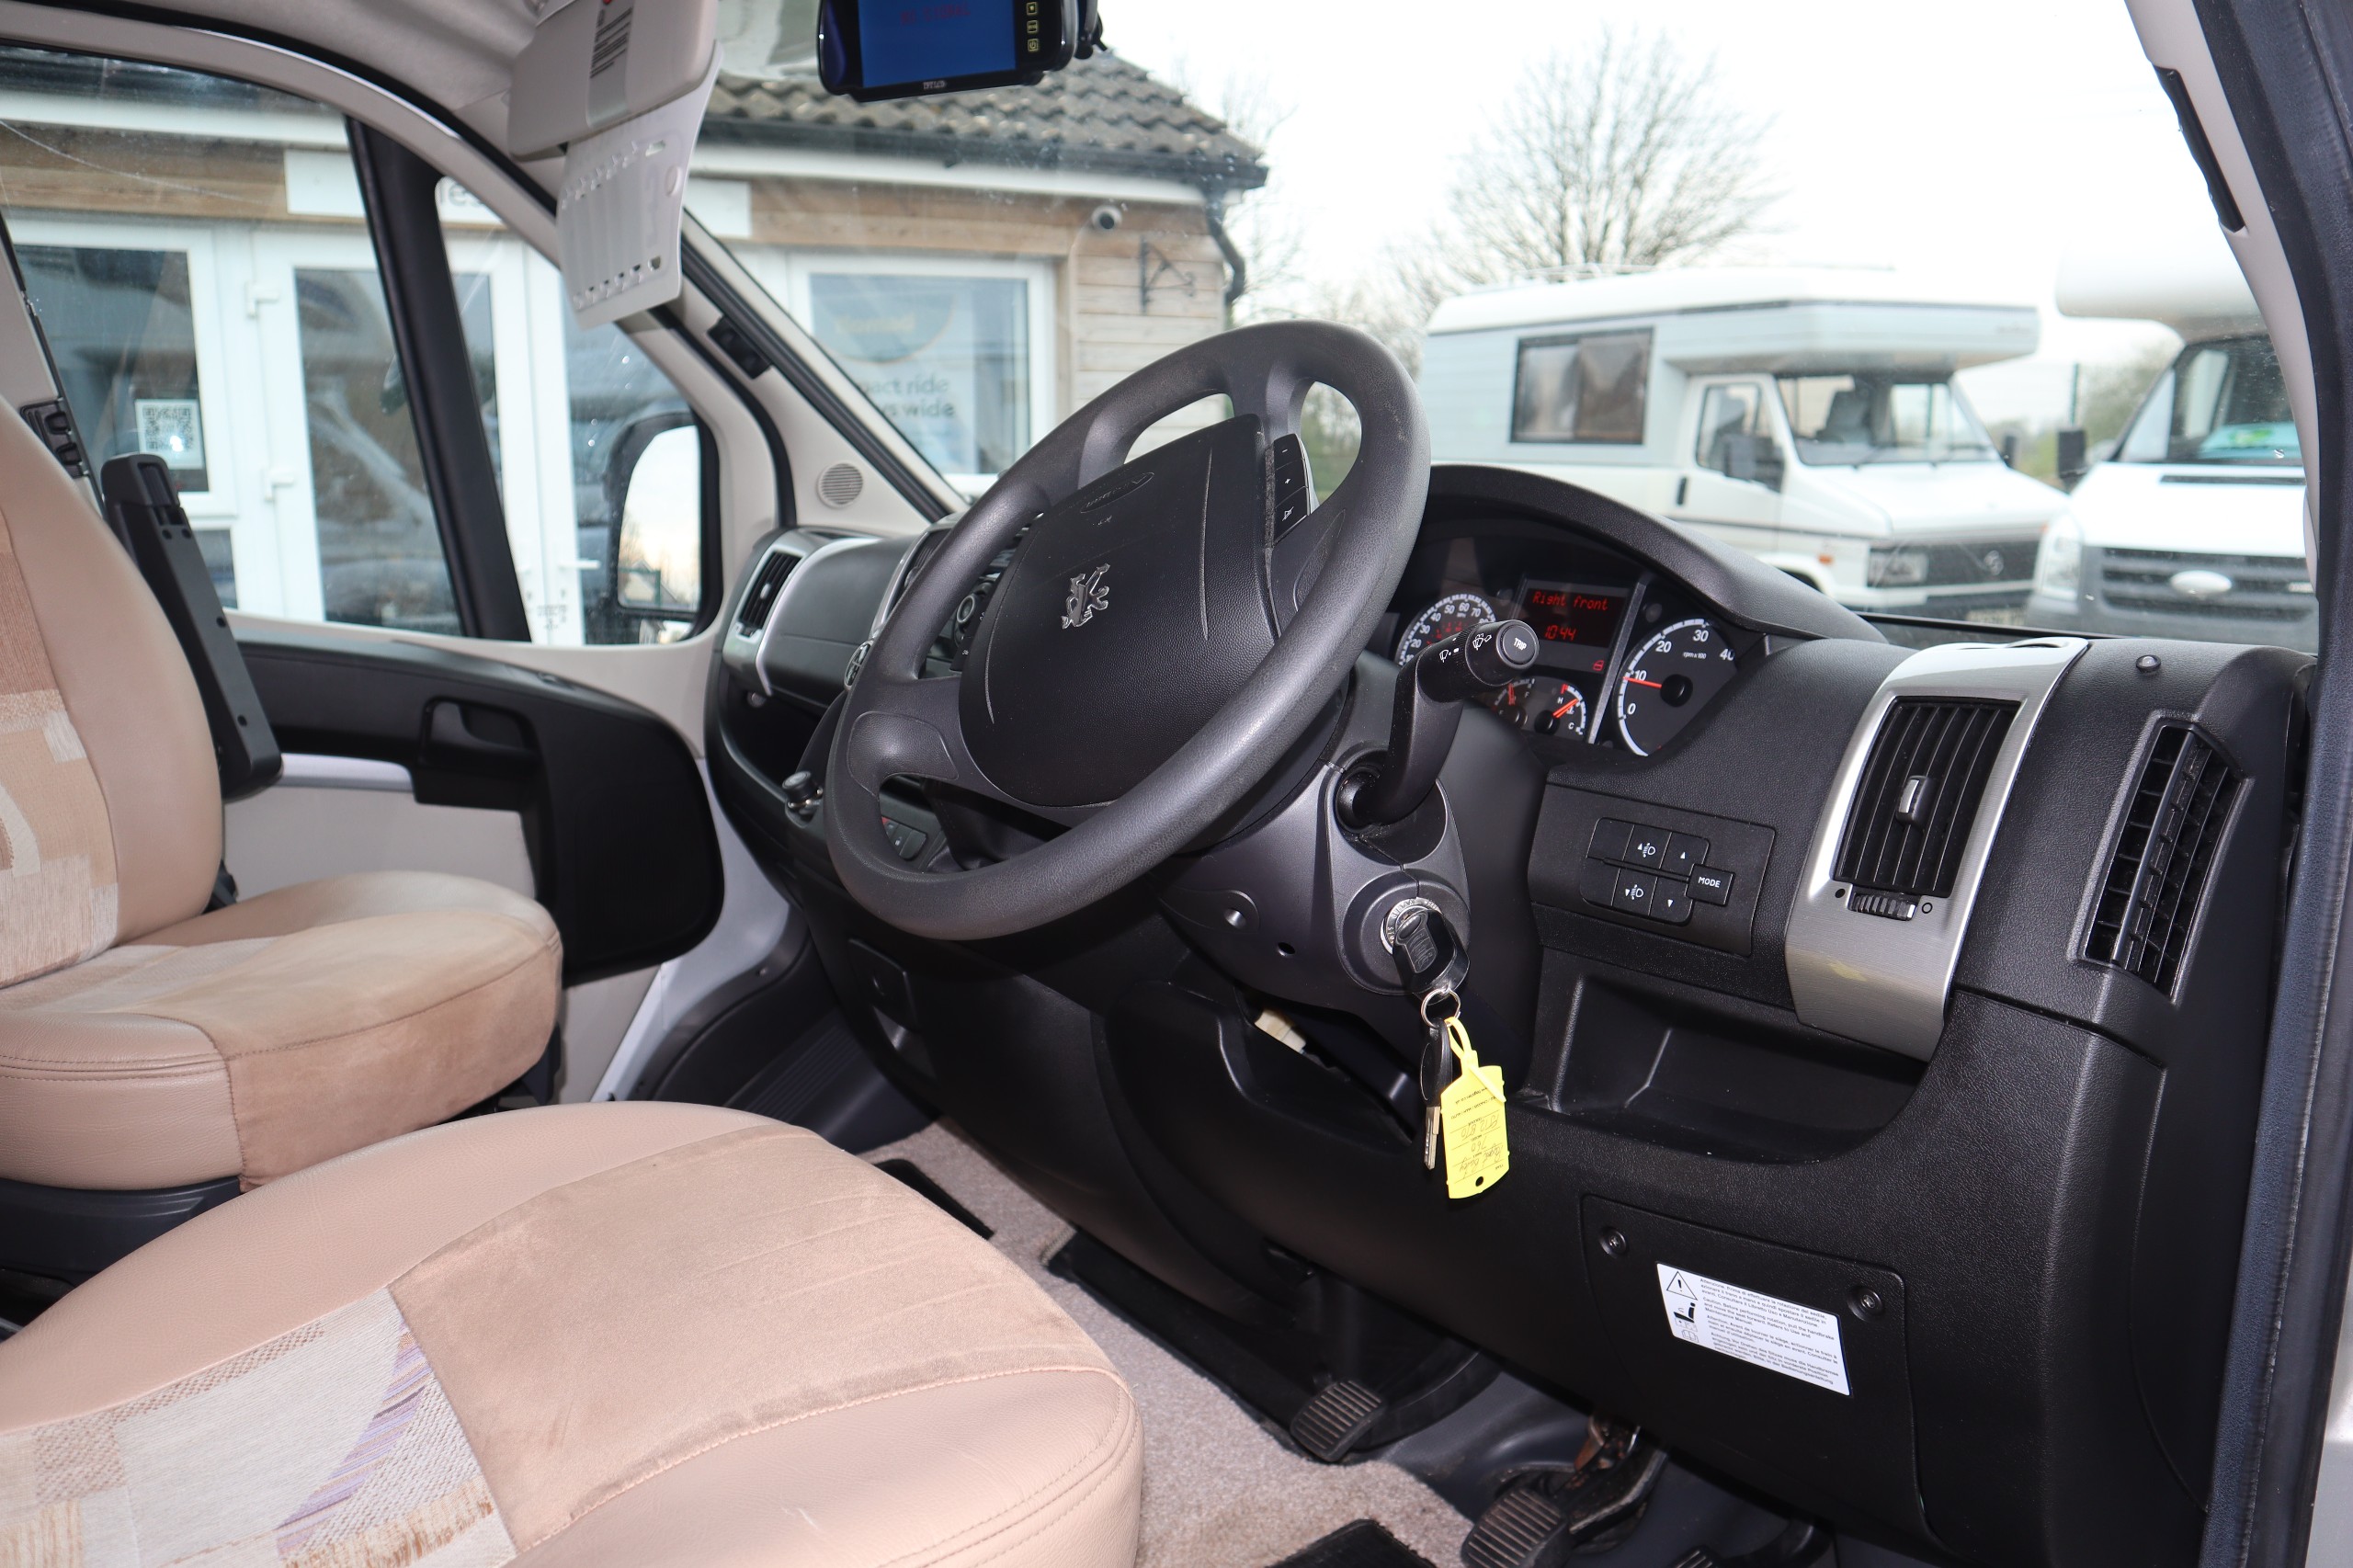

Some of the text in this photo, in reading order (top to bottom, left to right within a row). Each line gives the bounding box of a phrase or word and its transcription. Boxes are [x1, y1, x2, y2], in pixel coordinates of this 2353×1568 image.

[1532, 591, 1608, 611] Right front
[1444, 605, 1455, 614] 50
[1459, 602, 1470, 612] 60
[1430, 612, 1441, 621] 40
[1471, 608, 1482, 618] 70
[1419, 625, 1431, 634] 30
[1693, 630, 1709, 642] 30
[1410, 639, 1422, 648] 20
[1514, 637, 1527, 650] TRIP
[1655, 641, 1672, 653] 20
[1634, 670, 1647, 681] 10
[1627, 702, 1636, 715] 0
[1698, 877, 1722, 888] MODE
